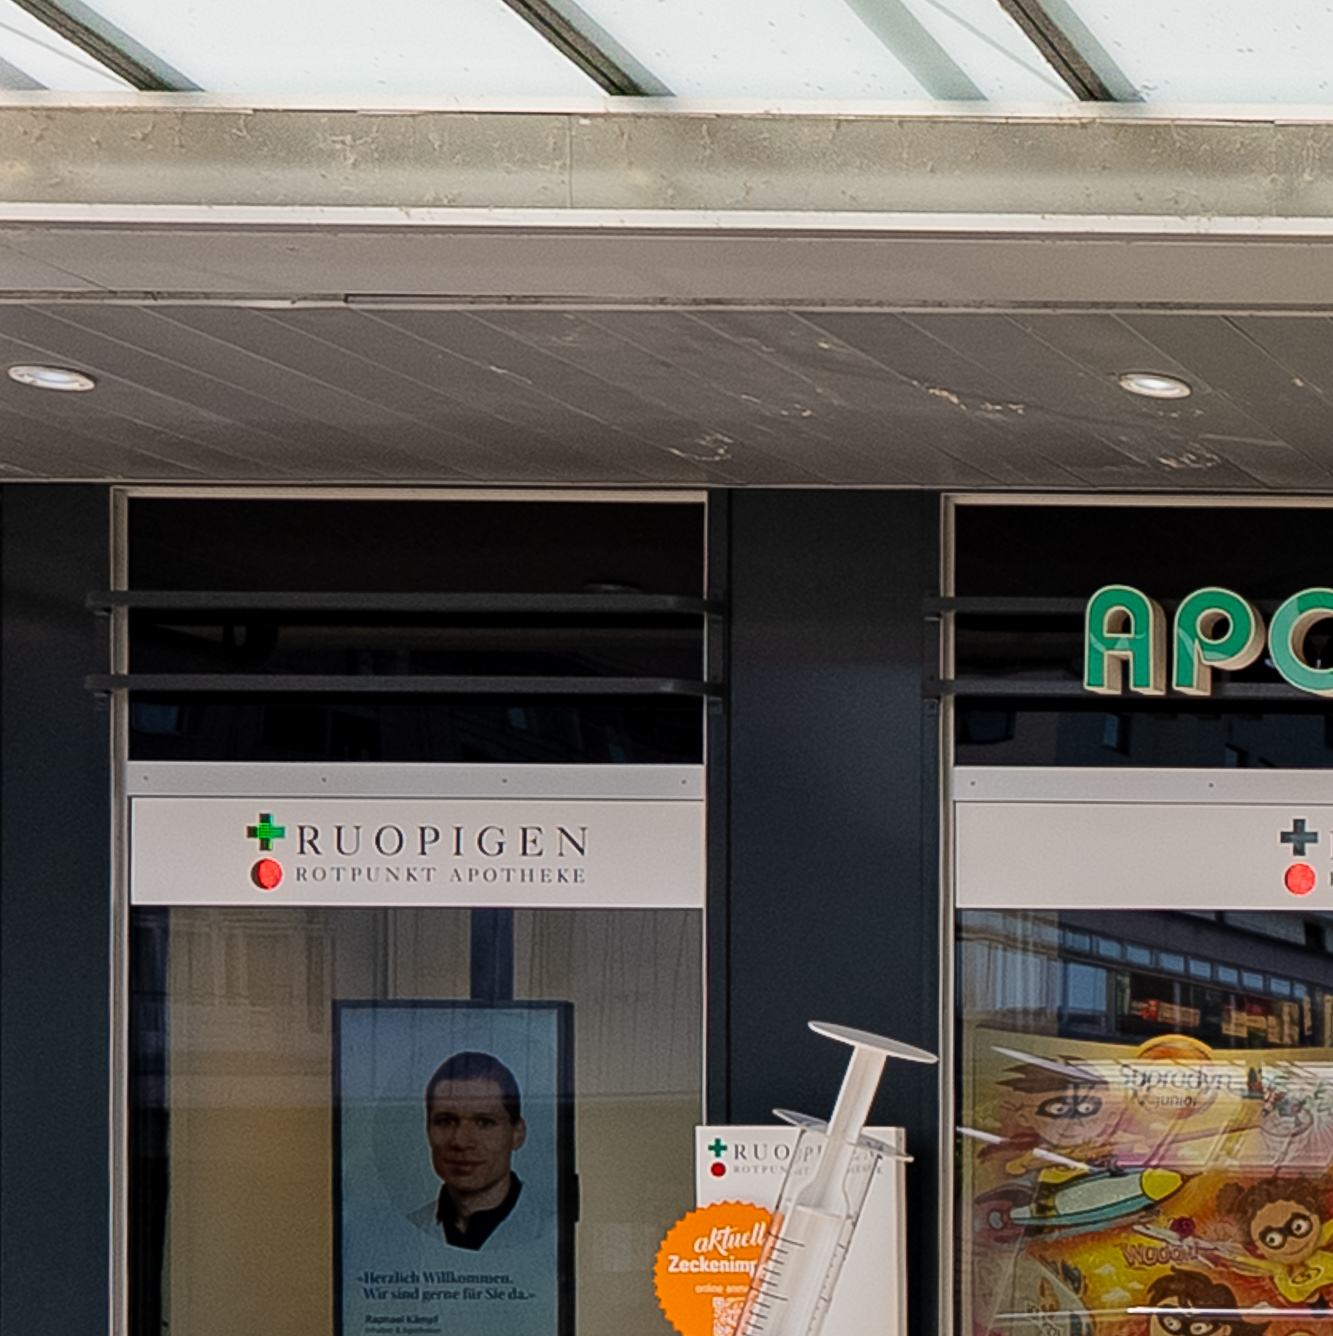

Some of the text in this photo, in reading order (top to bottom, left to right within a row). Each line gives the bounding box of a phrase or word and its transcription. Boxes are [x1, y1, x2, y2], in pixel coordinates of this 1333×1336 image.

[297, 824, 590, 856] RUOPIGEN
[295, 867, 587, 884] ROTPUNKT APOTHEKE
[694, 1222, 766, 1256] aktuell
[422, 1271, 514, 1284] Willkommen.
[362, 1288, 391, 1300] Wir
[392, 1287, 419, 1300] sind
[422, 1289, 459, 1303] gerne
[463, 1288, 482, 1300] für
[485, 1288, 505, 1300] Sie
